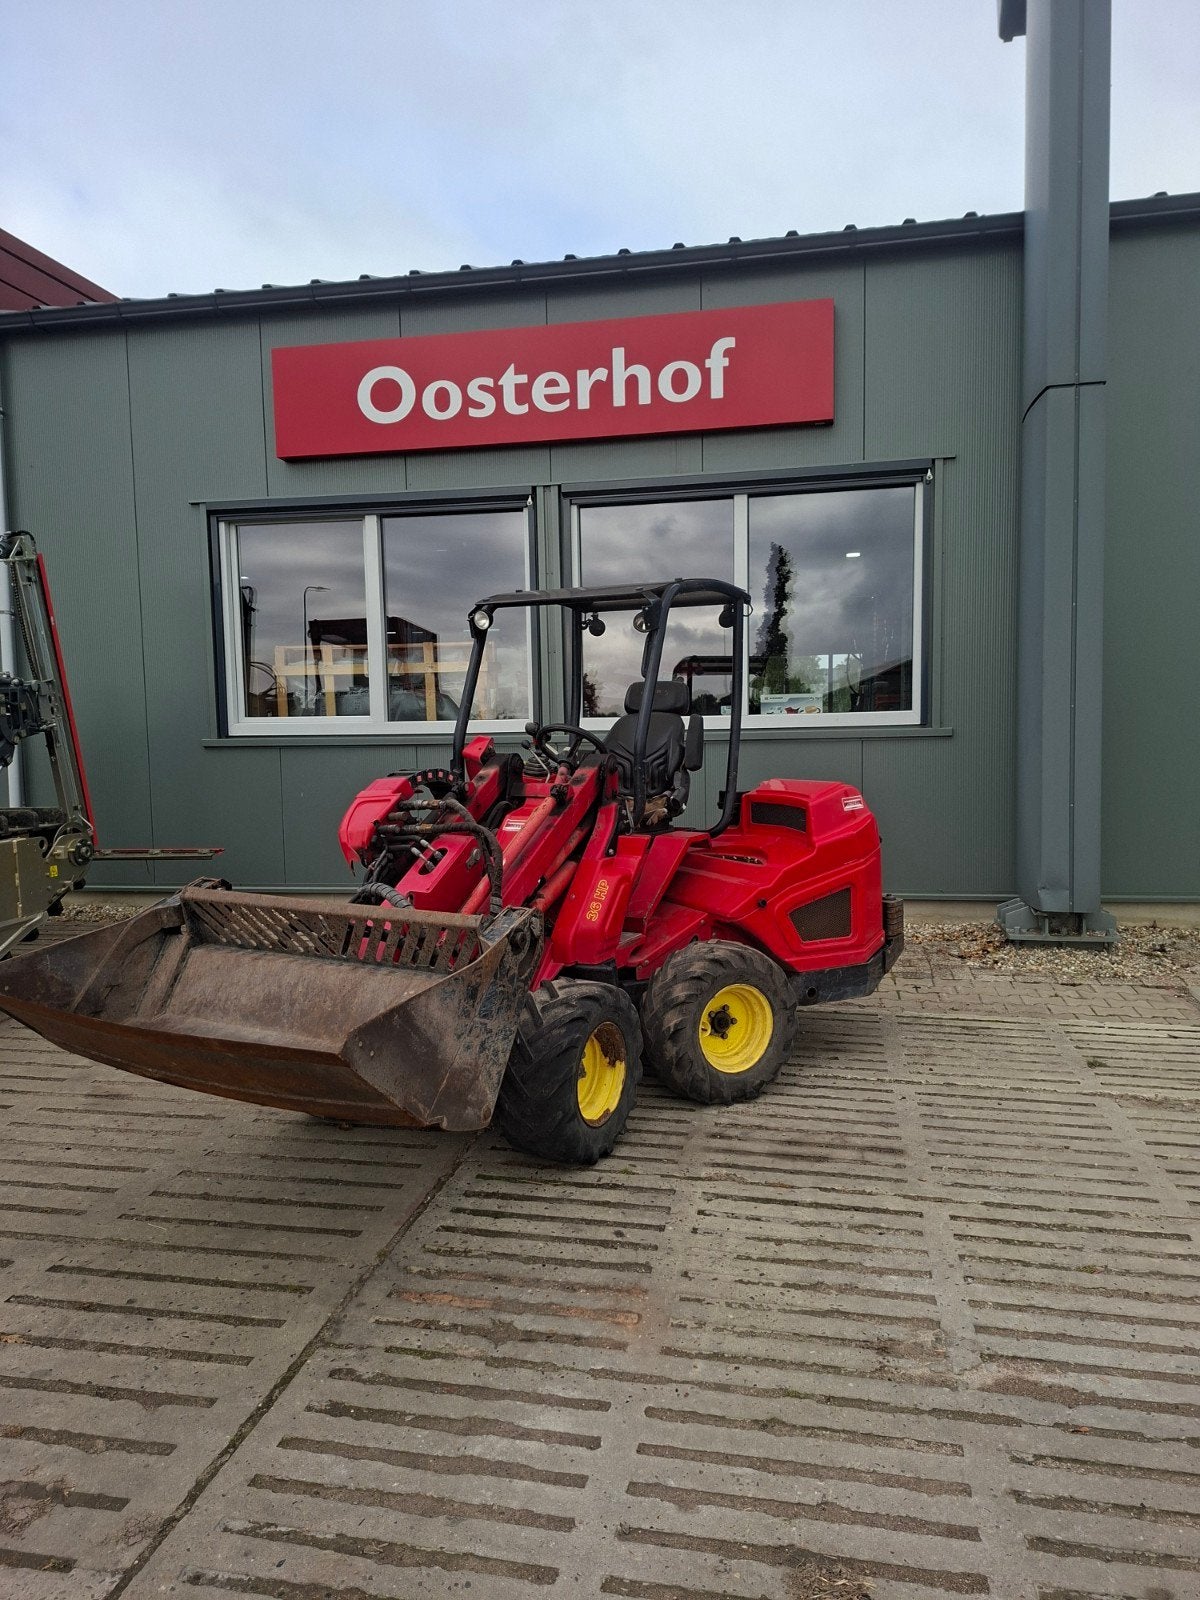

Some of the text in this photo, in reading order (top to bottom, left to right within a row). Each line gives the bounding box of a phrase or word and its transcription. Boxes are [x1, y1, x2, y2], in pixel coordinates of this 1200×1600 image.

[356, 336, 737, 425] Oosterhof
[586, 879, 609, 922] 36 HP
